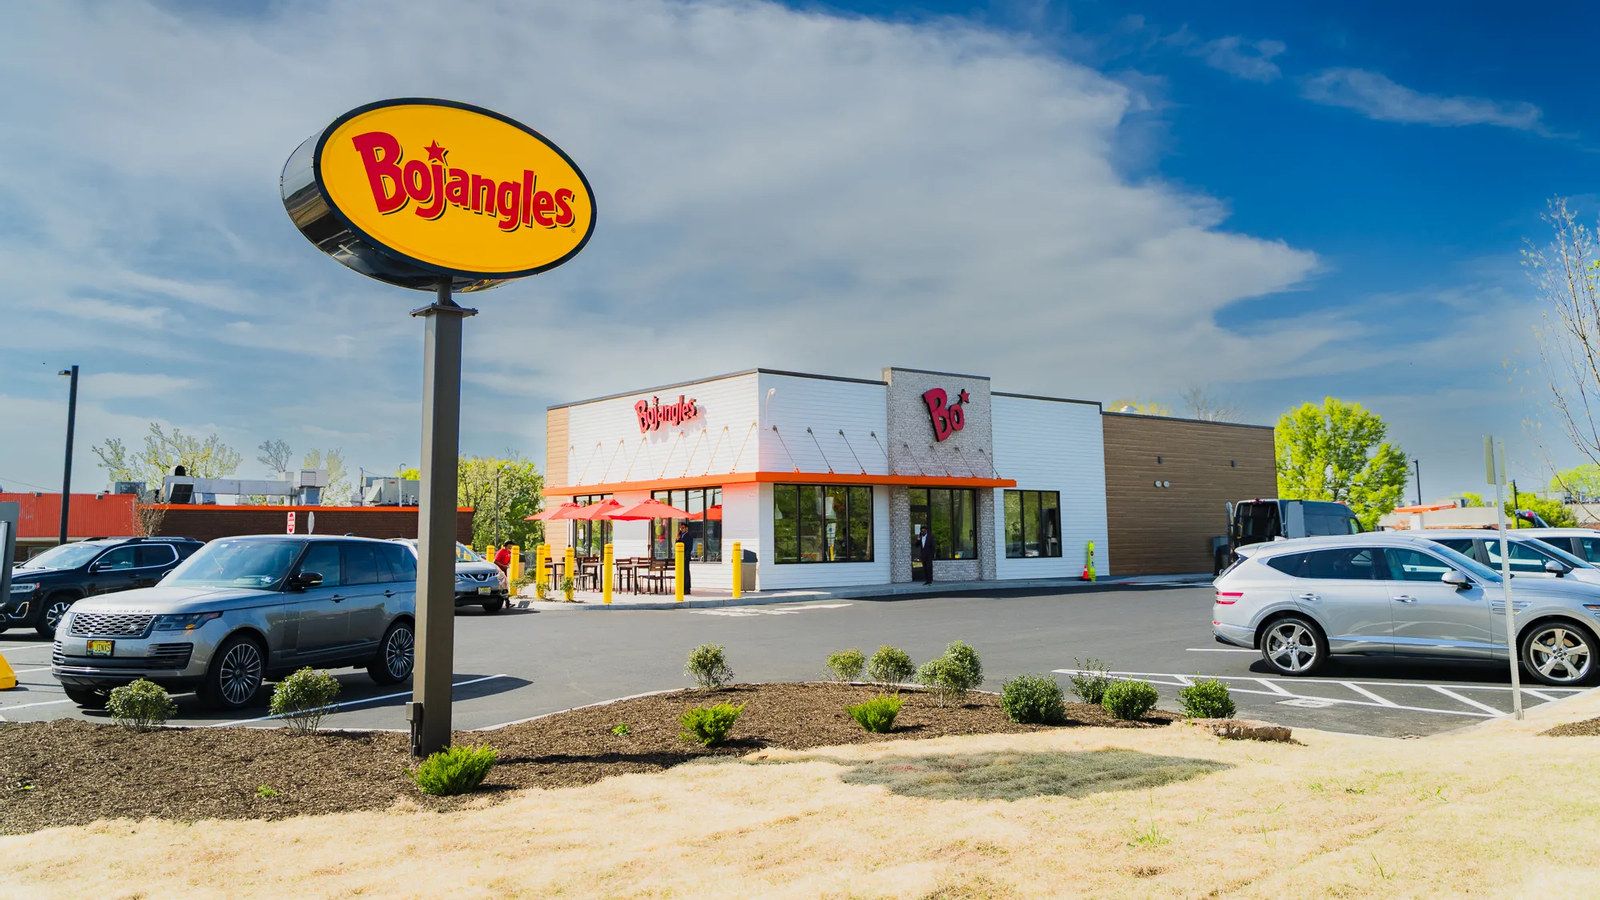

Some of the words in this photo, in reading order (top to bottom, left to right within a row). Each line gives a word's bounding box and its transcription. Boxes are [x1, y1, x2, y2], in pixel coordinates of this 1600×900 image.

[351, 131, 575, 232] Bojangles
[635, 395, 697, 434] Bojangles
[922, 388, 965, 442] Bo
